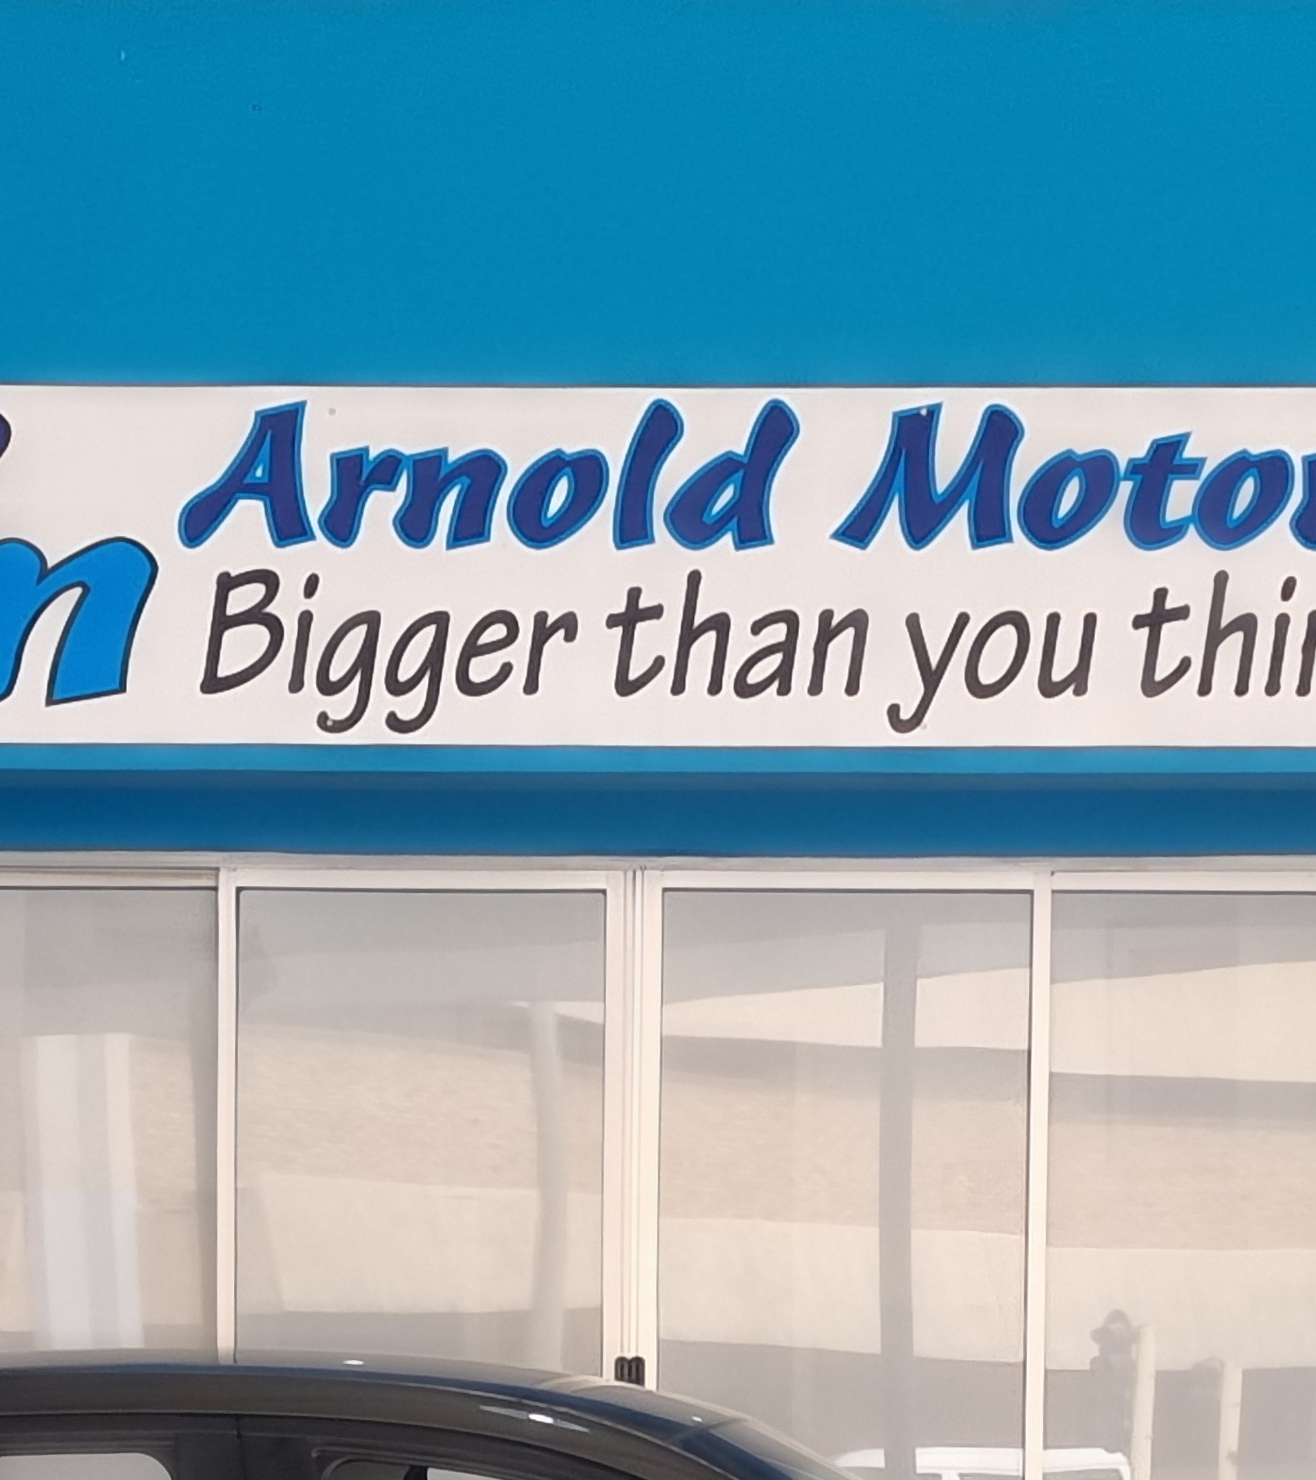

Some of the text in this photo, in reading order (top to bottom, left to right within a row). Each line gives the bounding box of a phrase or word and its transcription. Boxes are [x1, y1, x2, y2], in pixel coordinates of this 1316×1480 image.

[178, 398, 801, 552] Arnold
[199, 569, 578, 735] Bigger
[605, 570, 869, 700] than
[886, 610, 1098, 735] you
